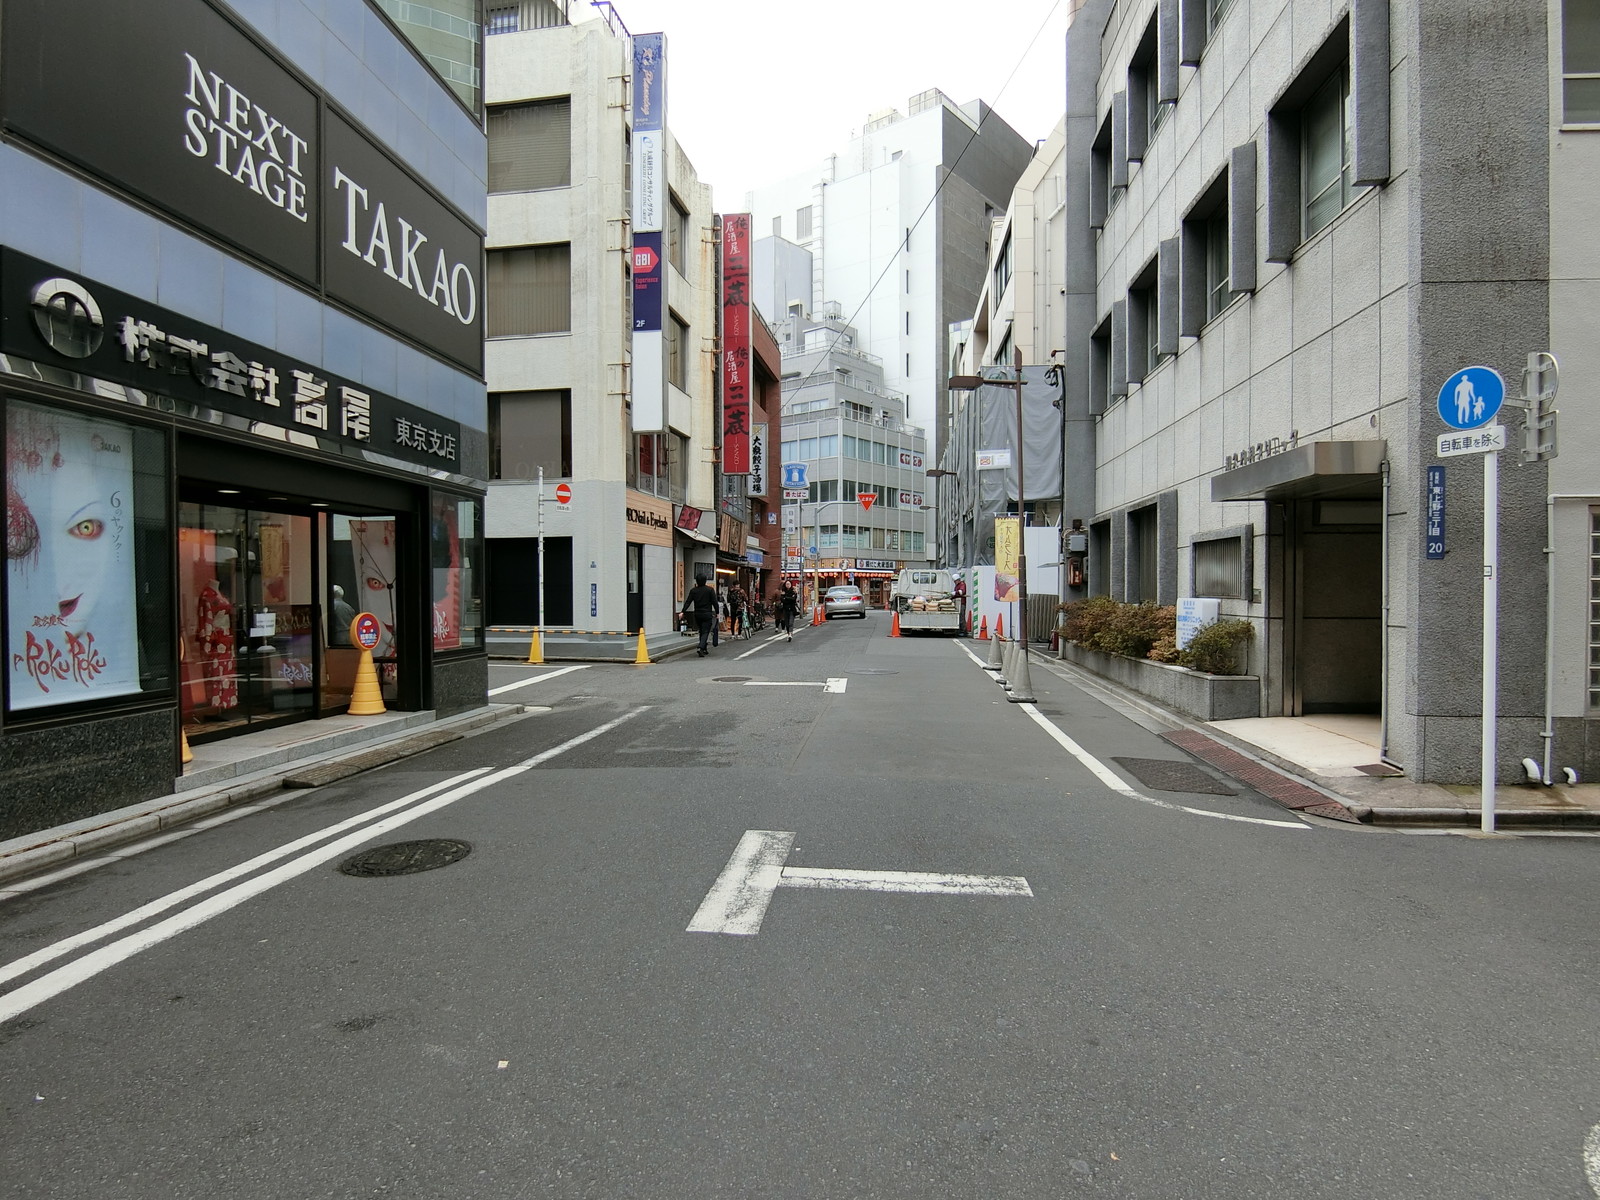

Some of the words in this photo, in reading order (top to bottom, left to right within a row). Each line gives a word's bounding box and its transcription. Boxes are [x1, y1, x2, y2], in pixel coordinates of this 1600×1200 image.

[184, 52, 309, 178] NEXT
[184, 109, 309, 223] STAGE
[334, 166, 477, 326] TAKAO
[725, 221, 741, 255] 居酒屋
[635, 253, 651, 266] GBI
[724, 256, 749, 307] 三蔵
[635, 319, 646, 328] 2F
[725, 350, 741, 384] 居酒屋
[733, 346, 749, 368] 俺の
[724, 385, 749, 437] 三蔵
[395, 417, 456, 461] 東京支店
[1440, 433, 1501, 453] 自転車を除く
[1432, 486, 1441, 536] 東上野三丁目
[1428, 542, 1443, 554] 20
